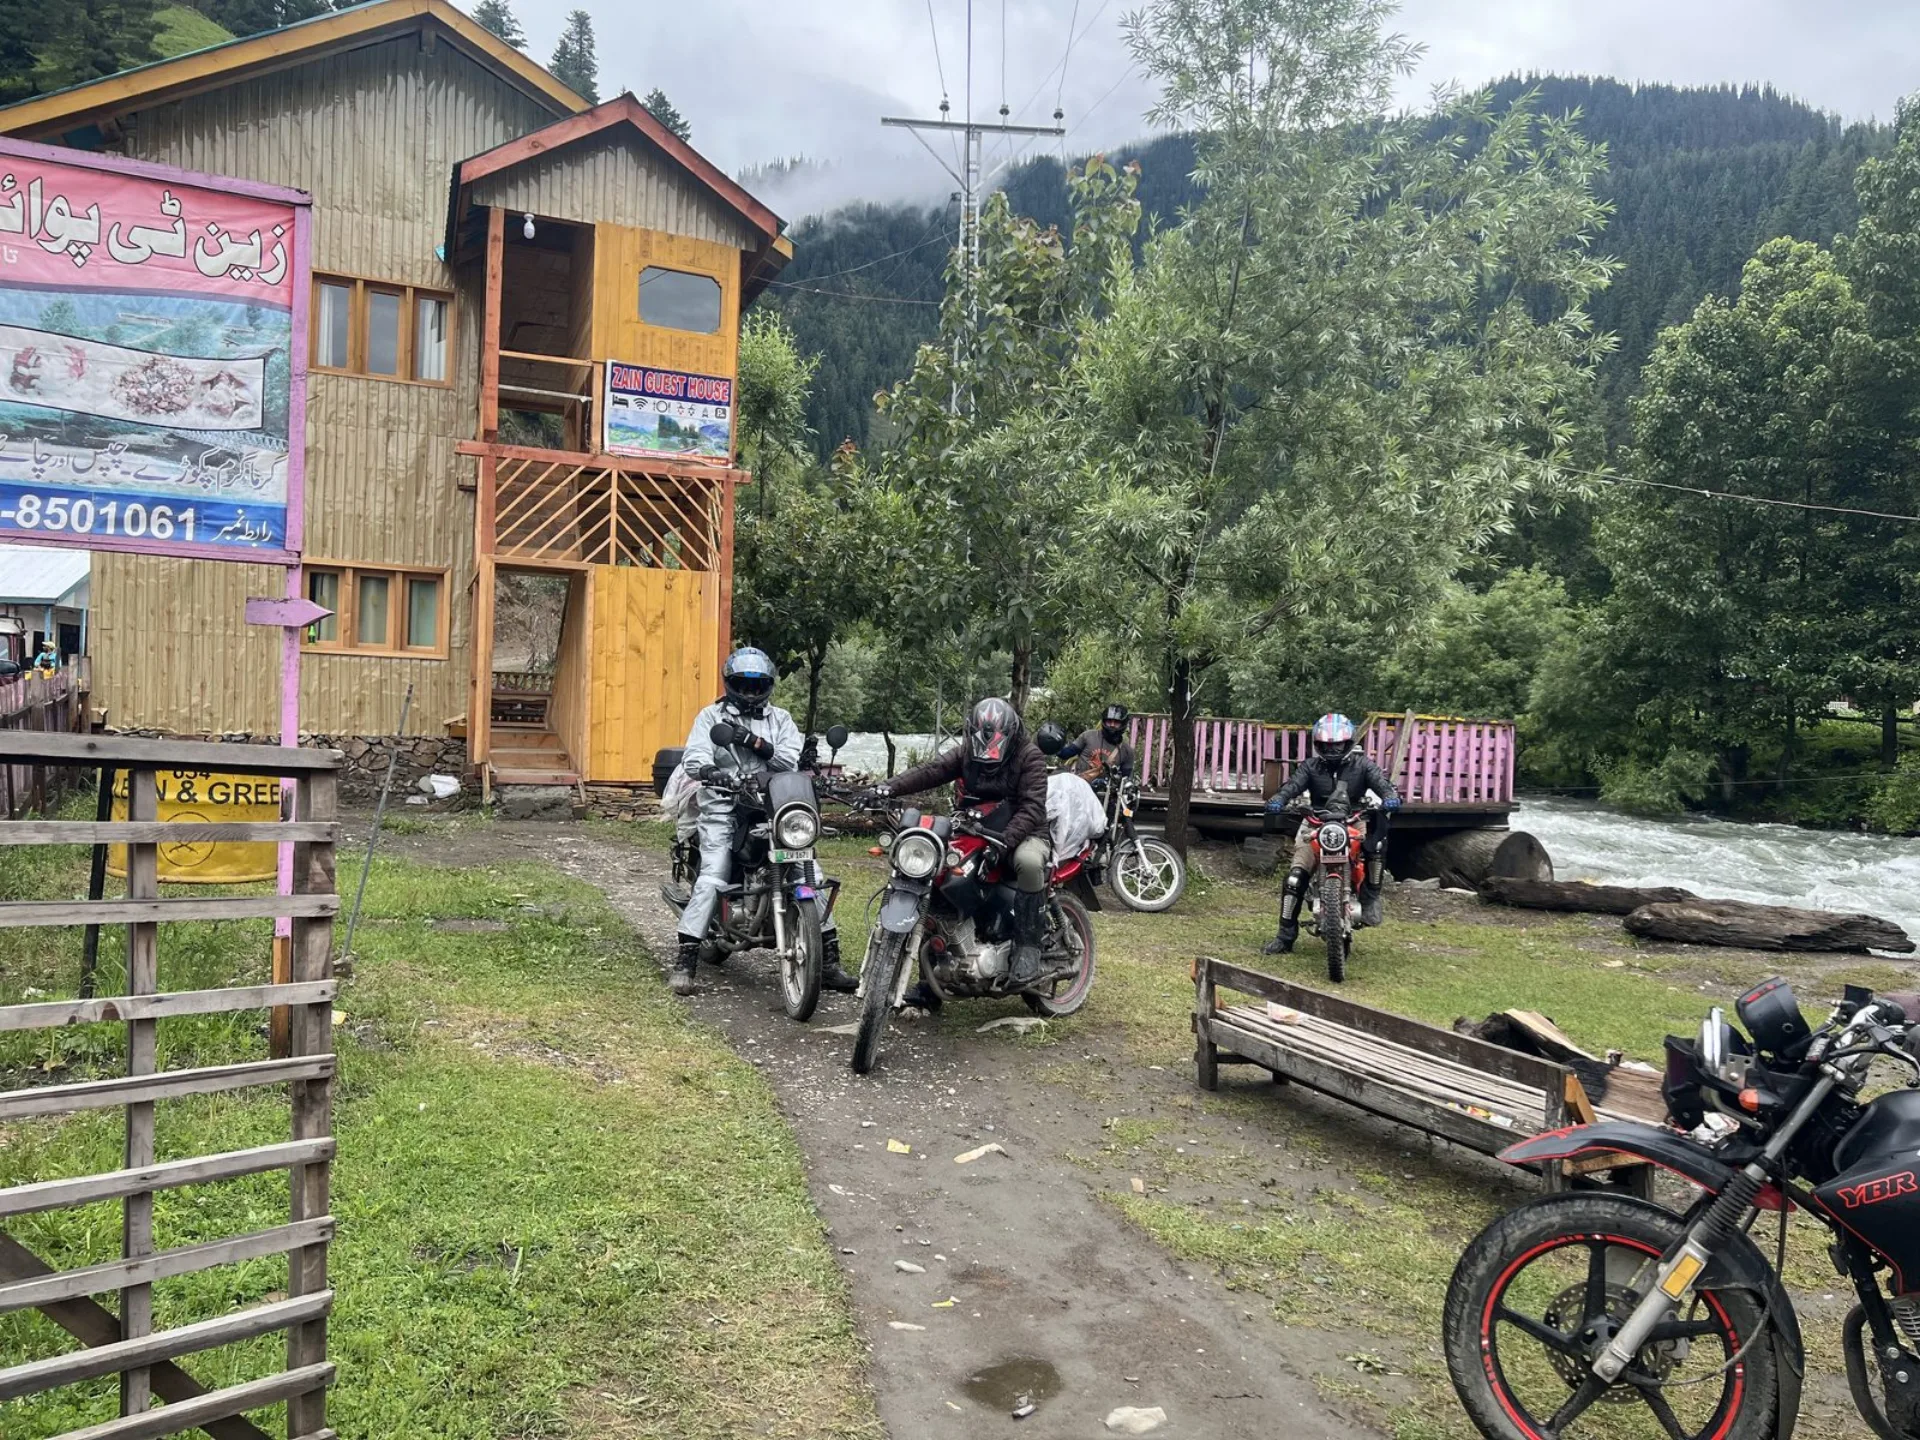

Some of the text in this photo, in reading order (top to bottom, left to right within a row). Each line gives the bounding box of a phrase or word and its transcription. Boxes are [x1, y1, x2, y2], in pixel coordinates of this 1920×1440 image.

[107, 190, 187, 264] ٹی
[193, 222, 288, 286] زین
[612, 366, 729, 402] ZAIN GUEST HOUSE
[0, 494, 195, 541] -8501061
[210, 508, 272, 547] رابطہ نمبر
[176, 780, 198, 803] &
[208, 781, 280, 805] GREE
[1836, 1171, 1919, 1208] YBR
